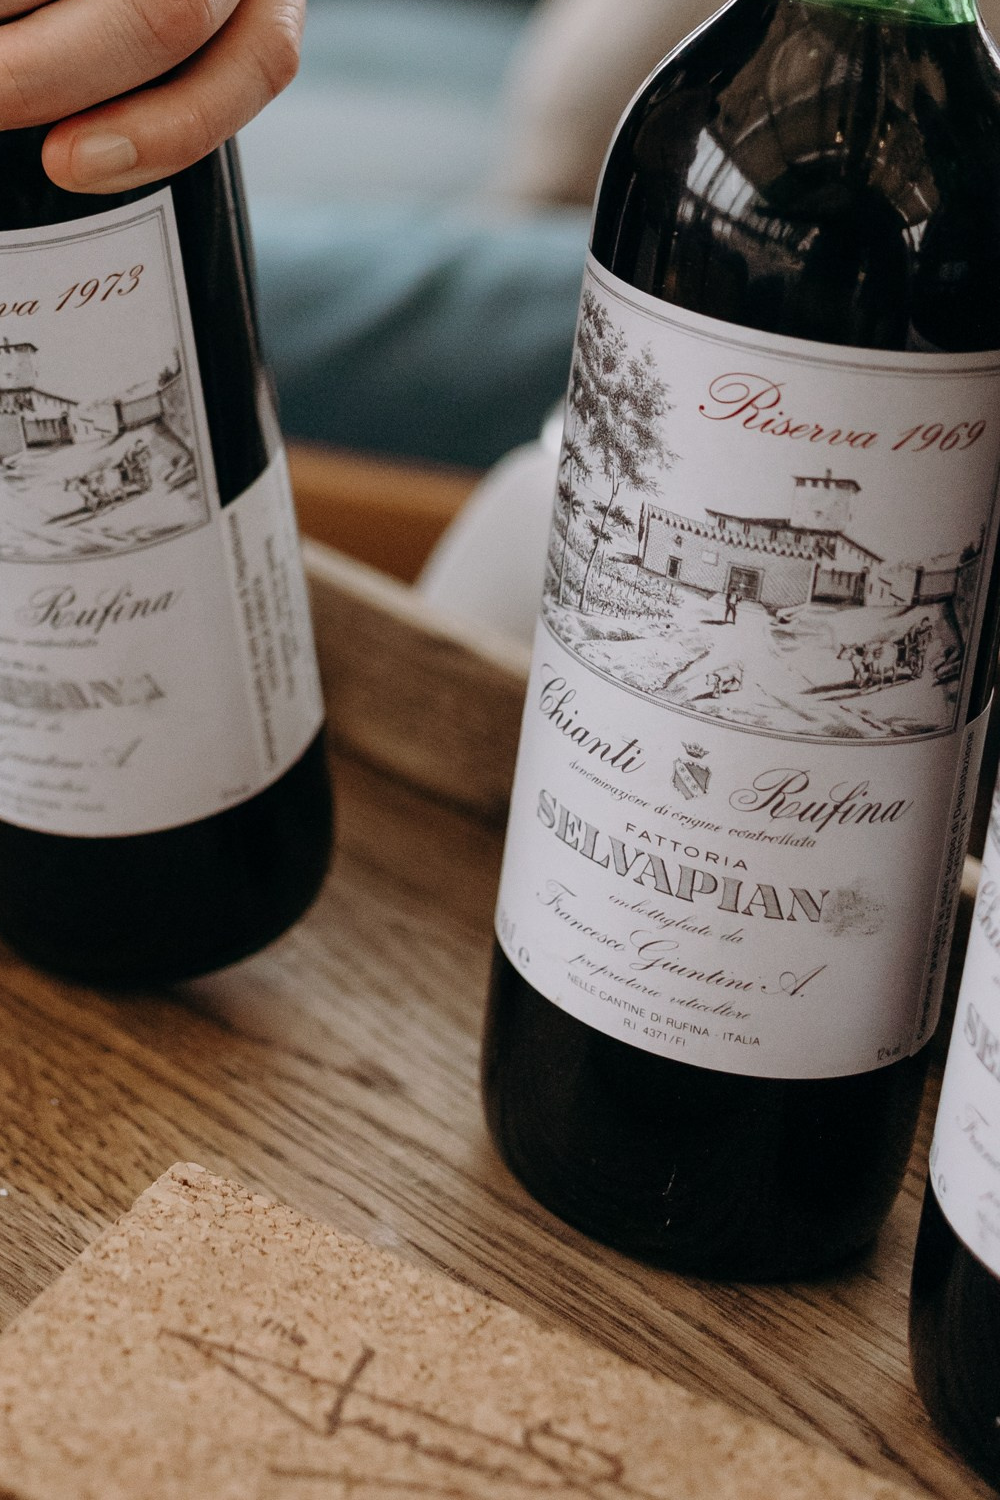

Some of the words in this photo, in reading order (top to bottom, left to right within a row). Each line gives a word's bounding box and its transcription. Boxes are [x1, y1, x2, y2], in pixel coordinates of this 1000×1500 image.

[55, 264, 144, 312] 1973
[699, 372, 879, 449] Riserva
[892, 419, 986, 451] 1969
[14, 583, 181, 634] Rufina
[540, 663, 645, 774] Chianti
[729, 768, 914, 833] Rufina
[568, 759, 650, 809] denominazione
[654, 803, 668, 816] di
[671, 809, 723, 832] origine
[728, 827, 817, 848] controllata
[945, 837, 959, 879] scopo
[954, 731, 975, 819] Degustazione
[536, 789, 875, 930] SELVAPIAN
[626, 822, 748, 871] FATTORIA
[536, 880, 626, 953] Francesco
[629, 930, 753, 992] Giuntini
[609, 893, 713, 938] imbottigliato
[720, 928, 743, 944] da
[565, 953, 662, 999] proprietario
[669, 995, 751, 1020] viticoltore
[567, 971, 596, 996] NELLE
[599, 990, 645, 1018] CANTINE
[650, 1012, 661, 1024] DI
[666, 1017, 709, 1037] RUFINA
[723, 1032, 760, 1046] ITALIA
[642, 1025, 686, 1047] 4371/FI
